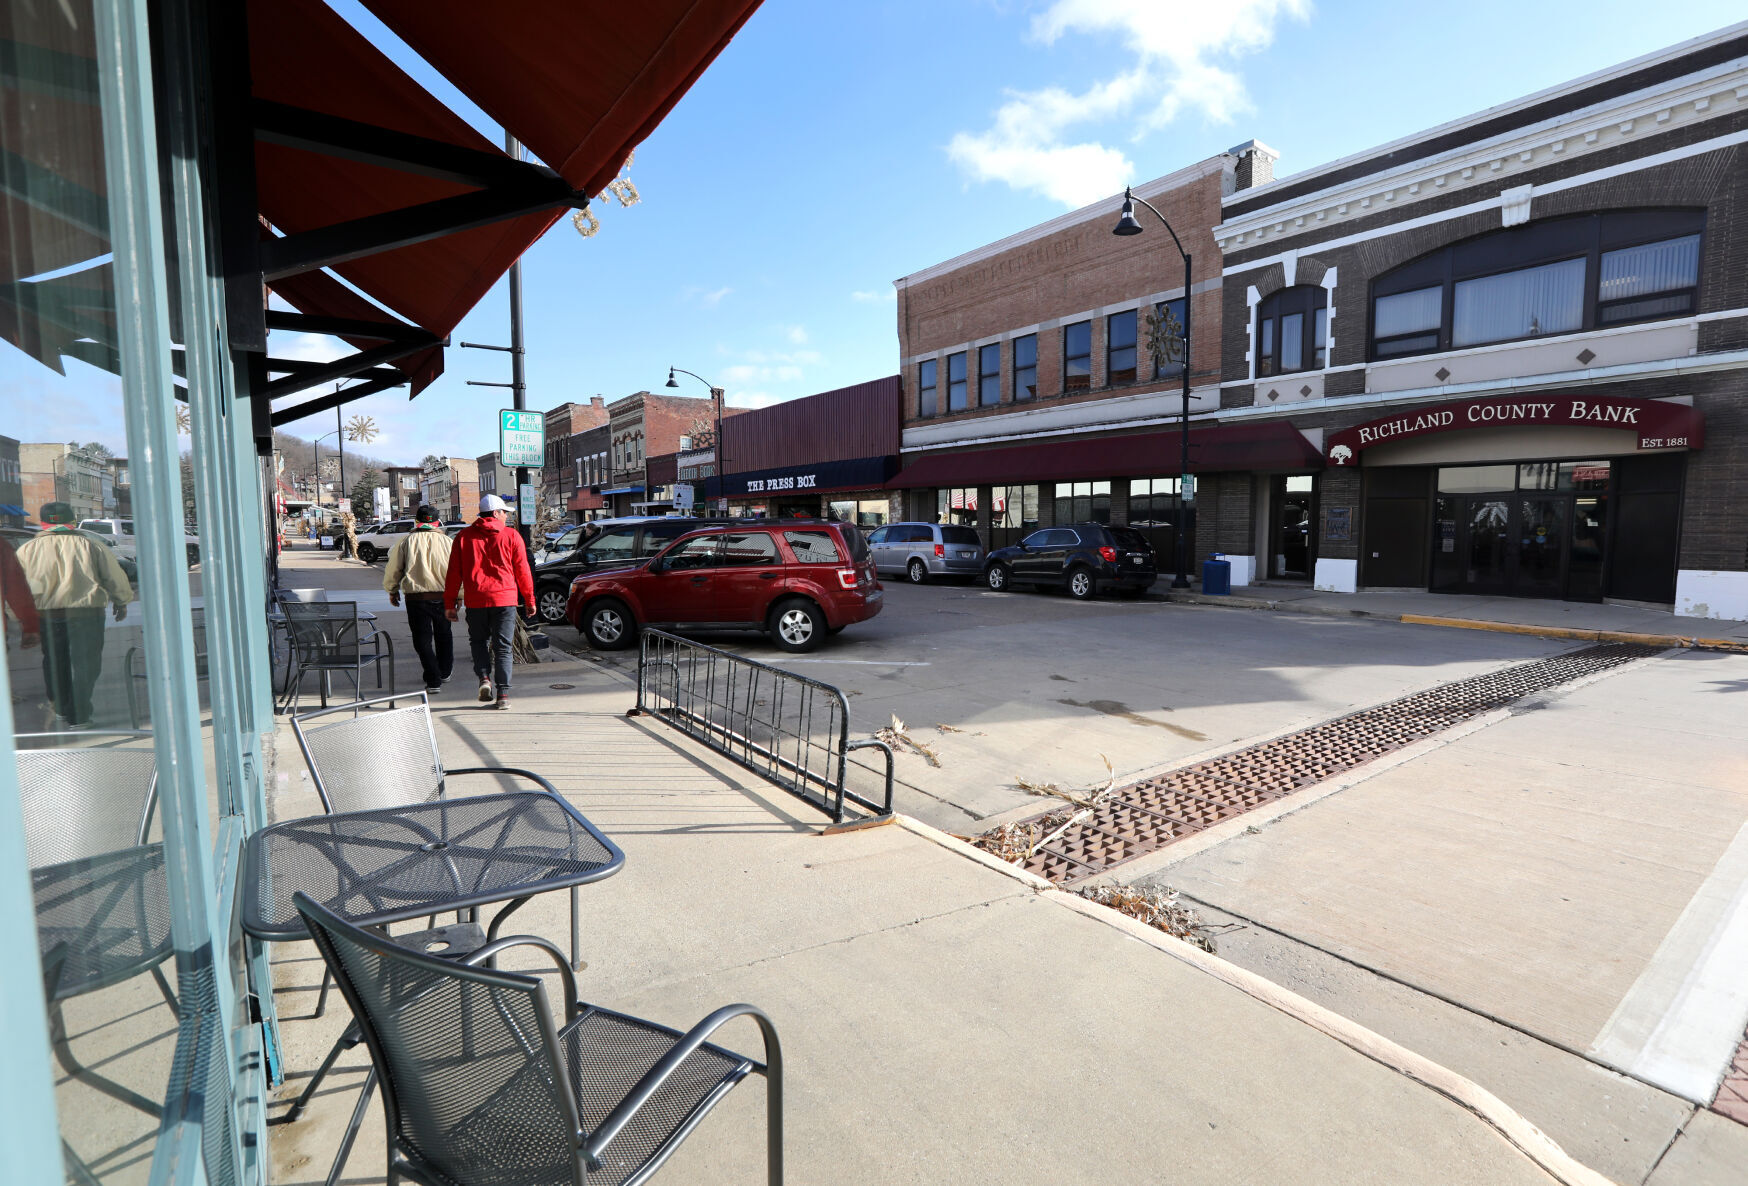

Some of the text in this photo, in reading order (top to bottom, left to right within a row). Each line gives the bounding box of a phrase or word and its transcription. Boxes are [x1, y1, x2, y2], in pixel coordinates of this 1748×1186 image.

[506, 414, 516, 429] 2
[525, 415, 536, 423] HR
[1358, 401, 1641, 444] RICHLAND COUNTY BANK
[515, 434, 532, 442] FREE
[1666, 437, 1688, 447] 1881
[509, 443, 537, 452] PARKING
[505, 453, 542, 462] THIS BLOCK
[747, 474, 816, 492] THE PRESS BOX
